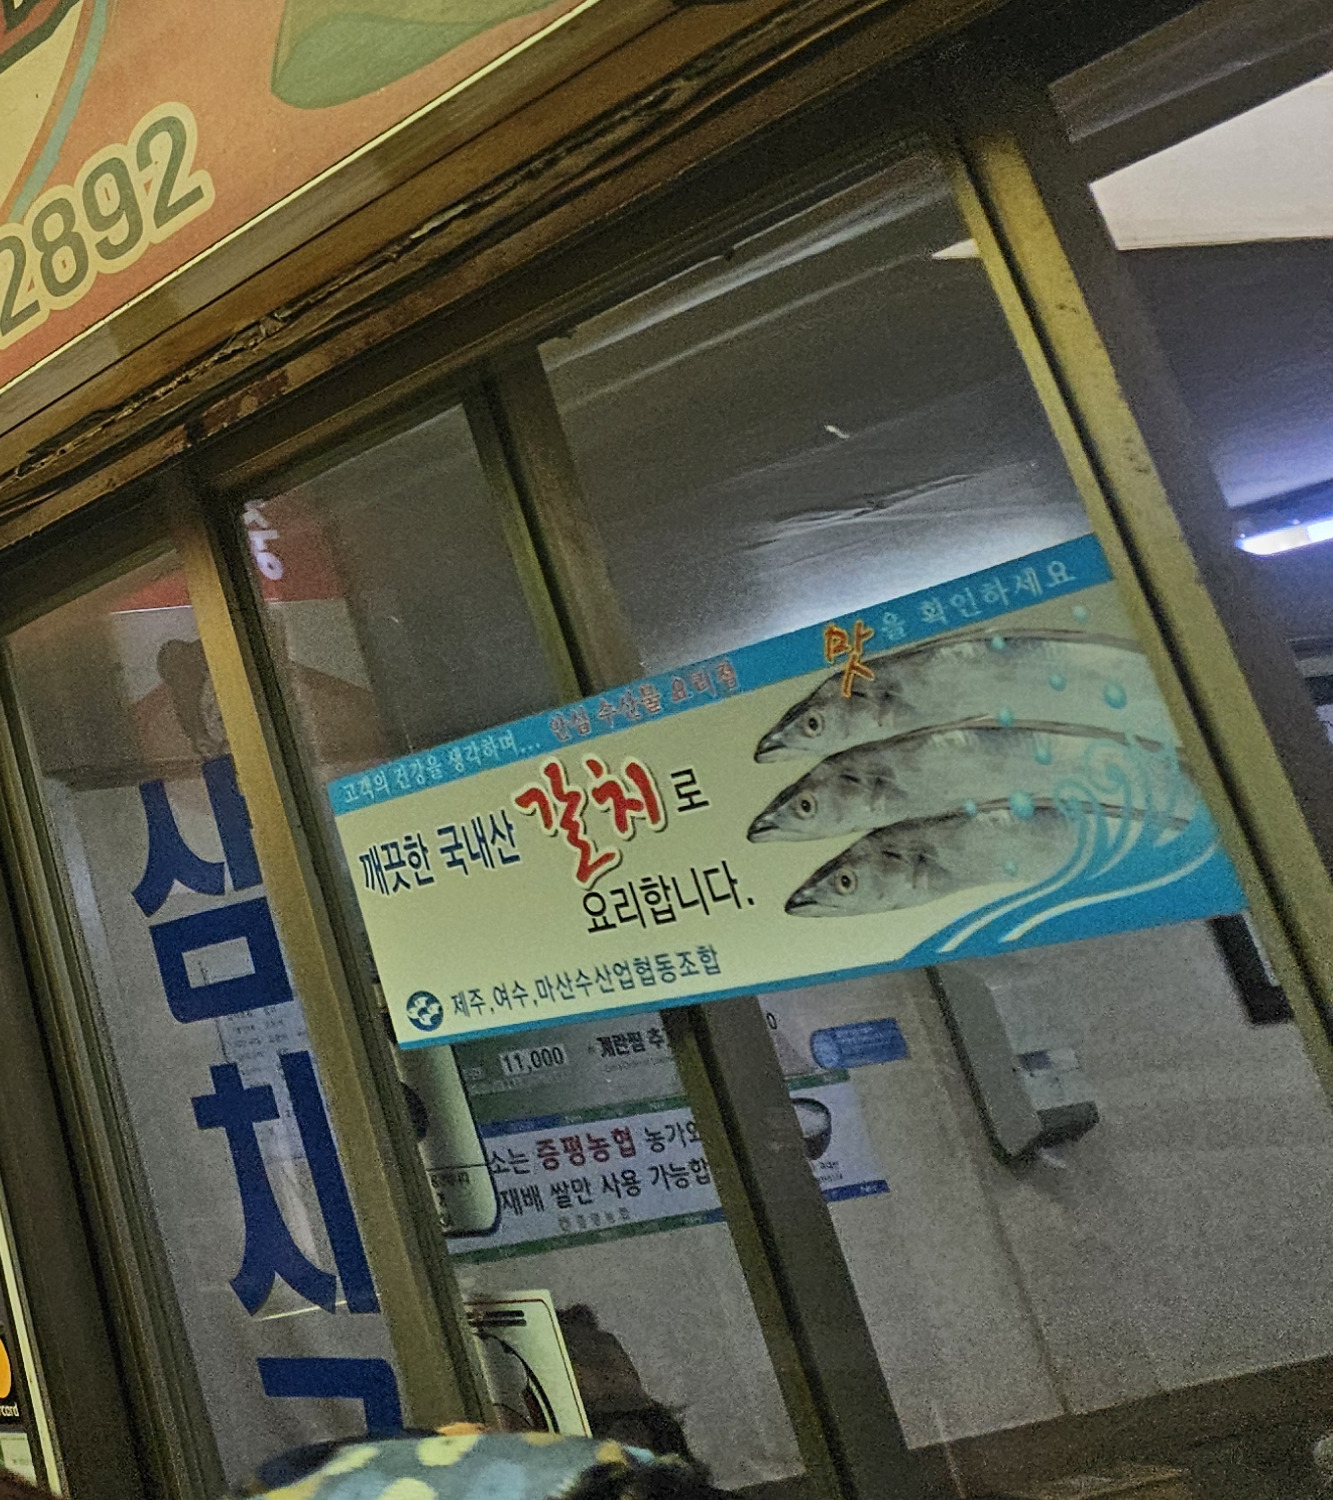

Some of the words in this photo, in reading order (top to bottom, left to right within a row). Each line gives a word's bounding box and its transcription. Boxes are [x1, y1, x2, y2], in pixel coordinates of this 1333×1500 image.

[340, 769, 391, 805] 고객의
[394, 754, 444, 791] 건강을
[919, 559, 1077, 626] 확인하세요
[358, 831, 437, 897] 깨끗한
[436, 808, 522, 876] 국내산
[582, 860, 755, 935] 요리합니다.
[503, 1046, 565, 1075] 11,000
[536, 1125, 639, 1173] 증평농협
[499, 1185, 545, 1217] 재배
[549, 1177, 594, 1210] 쌀만
[601, 1168, 642, 1200] 사용
